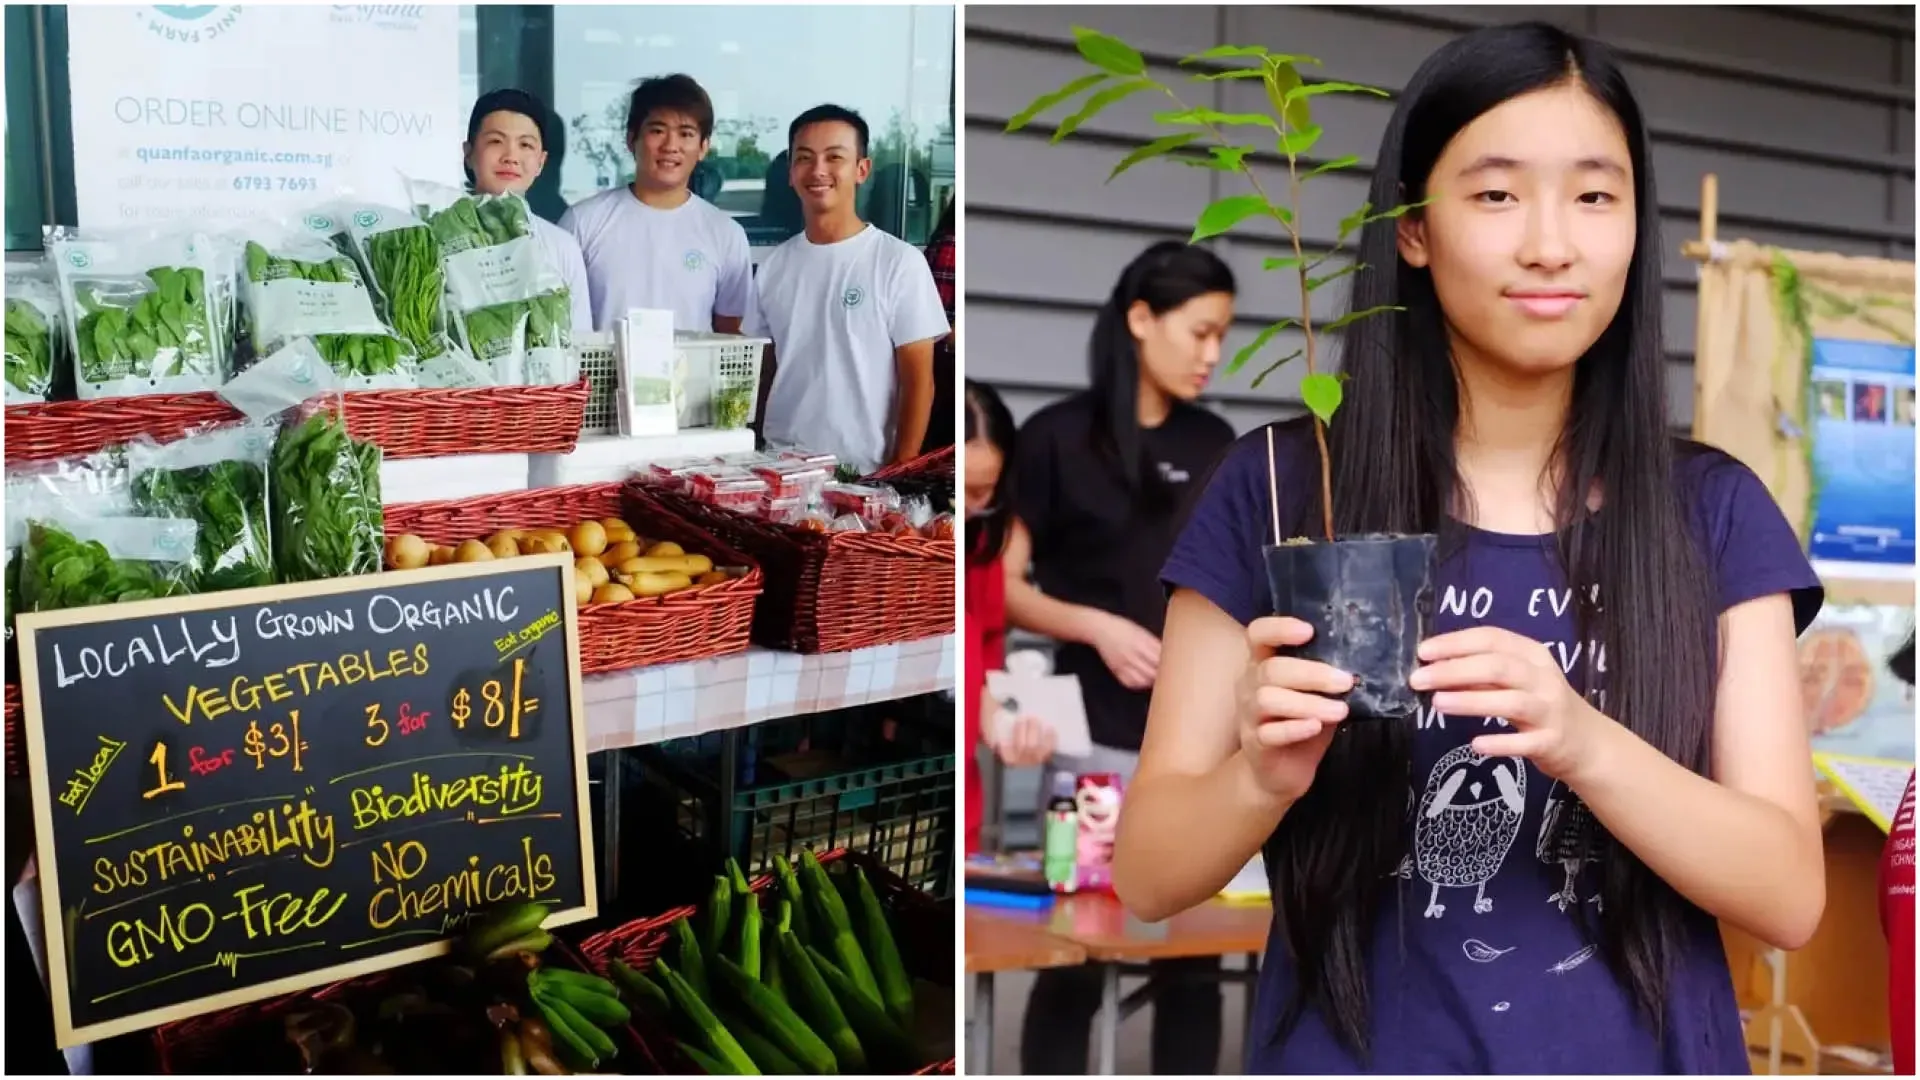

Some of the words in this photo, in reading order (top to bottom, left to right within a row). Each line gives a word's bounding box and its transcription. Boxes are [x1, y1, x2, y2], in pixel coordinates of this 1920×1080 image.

[147, 19, 201, 43] FARM
[114, 96, 227, 128] ORDER
[237, 101, 349, 134] ONLINE
[357, 107, 433, 137] NOW!
[135, 145, 333, 168] quanfaorganic.com.sg
[232, 175, 272, 191] 6793
[275, 176, 317, 192] 7693
[1439, 584, 1494, 618] NO
[1527, 583, 1604, 618] EVL
[53, 615, 241, 688] LOCALLY
[256, 607, 356, 640] GROWN
[367, 586, 519, 634] ORGANIC
[1542, 639, 1608, 674] VIL
[162, 642, 430, 725] VEGETABLES
[364, 702, 390, 746] 3
[395, 702, 432, 736] for
[142, 741, 186, 799] 1
[188, 746, 236, 776] for
[350, 761, 542, 830] Biodiversity
[369, 836, 556, 929] Chemicals
[370, 839, 428, 885] NO
[106, 883, 348, 968] GMO-Free
